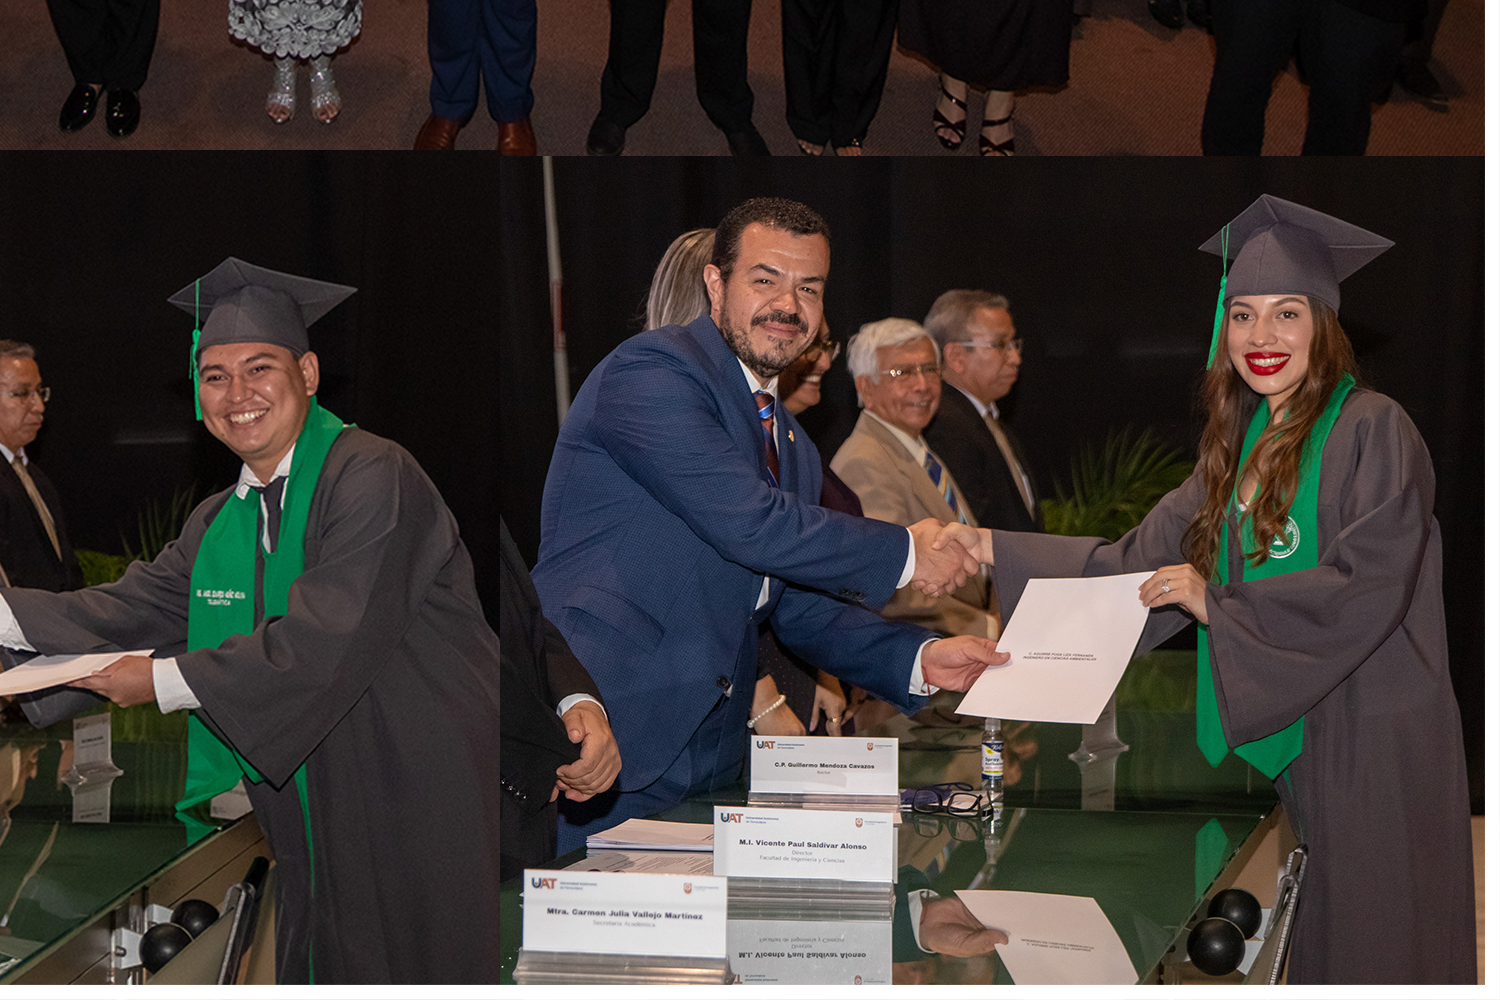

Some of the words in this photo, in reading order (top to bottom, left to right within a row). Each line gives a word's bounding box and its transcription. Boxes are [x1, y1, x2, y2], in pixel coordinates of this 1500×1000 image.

[756, 740, 776, 750] UAT
[720, 812, 744, 824] UAT
[739, 838, 754, 846] M.I.
[755, 839, 786, 847] Vicente
[787, 840, 805, 848] Paul
[806, 841, 839, 849] Saldívar
[840, 842, 867, 850] Alonso
[531, 877, 557, 890] UAT
[546, 907, 569, 916] Mtra.
[571, 908, 606, 917] Carmen
[608, 909, 630, 918] Julia
[632, 910, 662, 919] Vallejo
